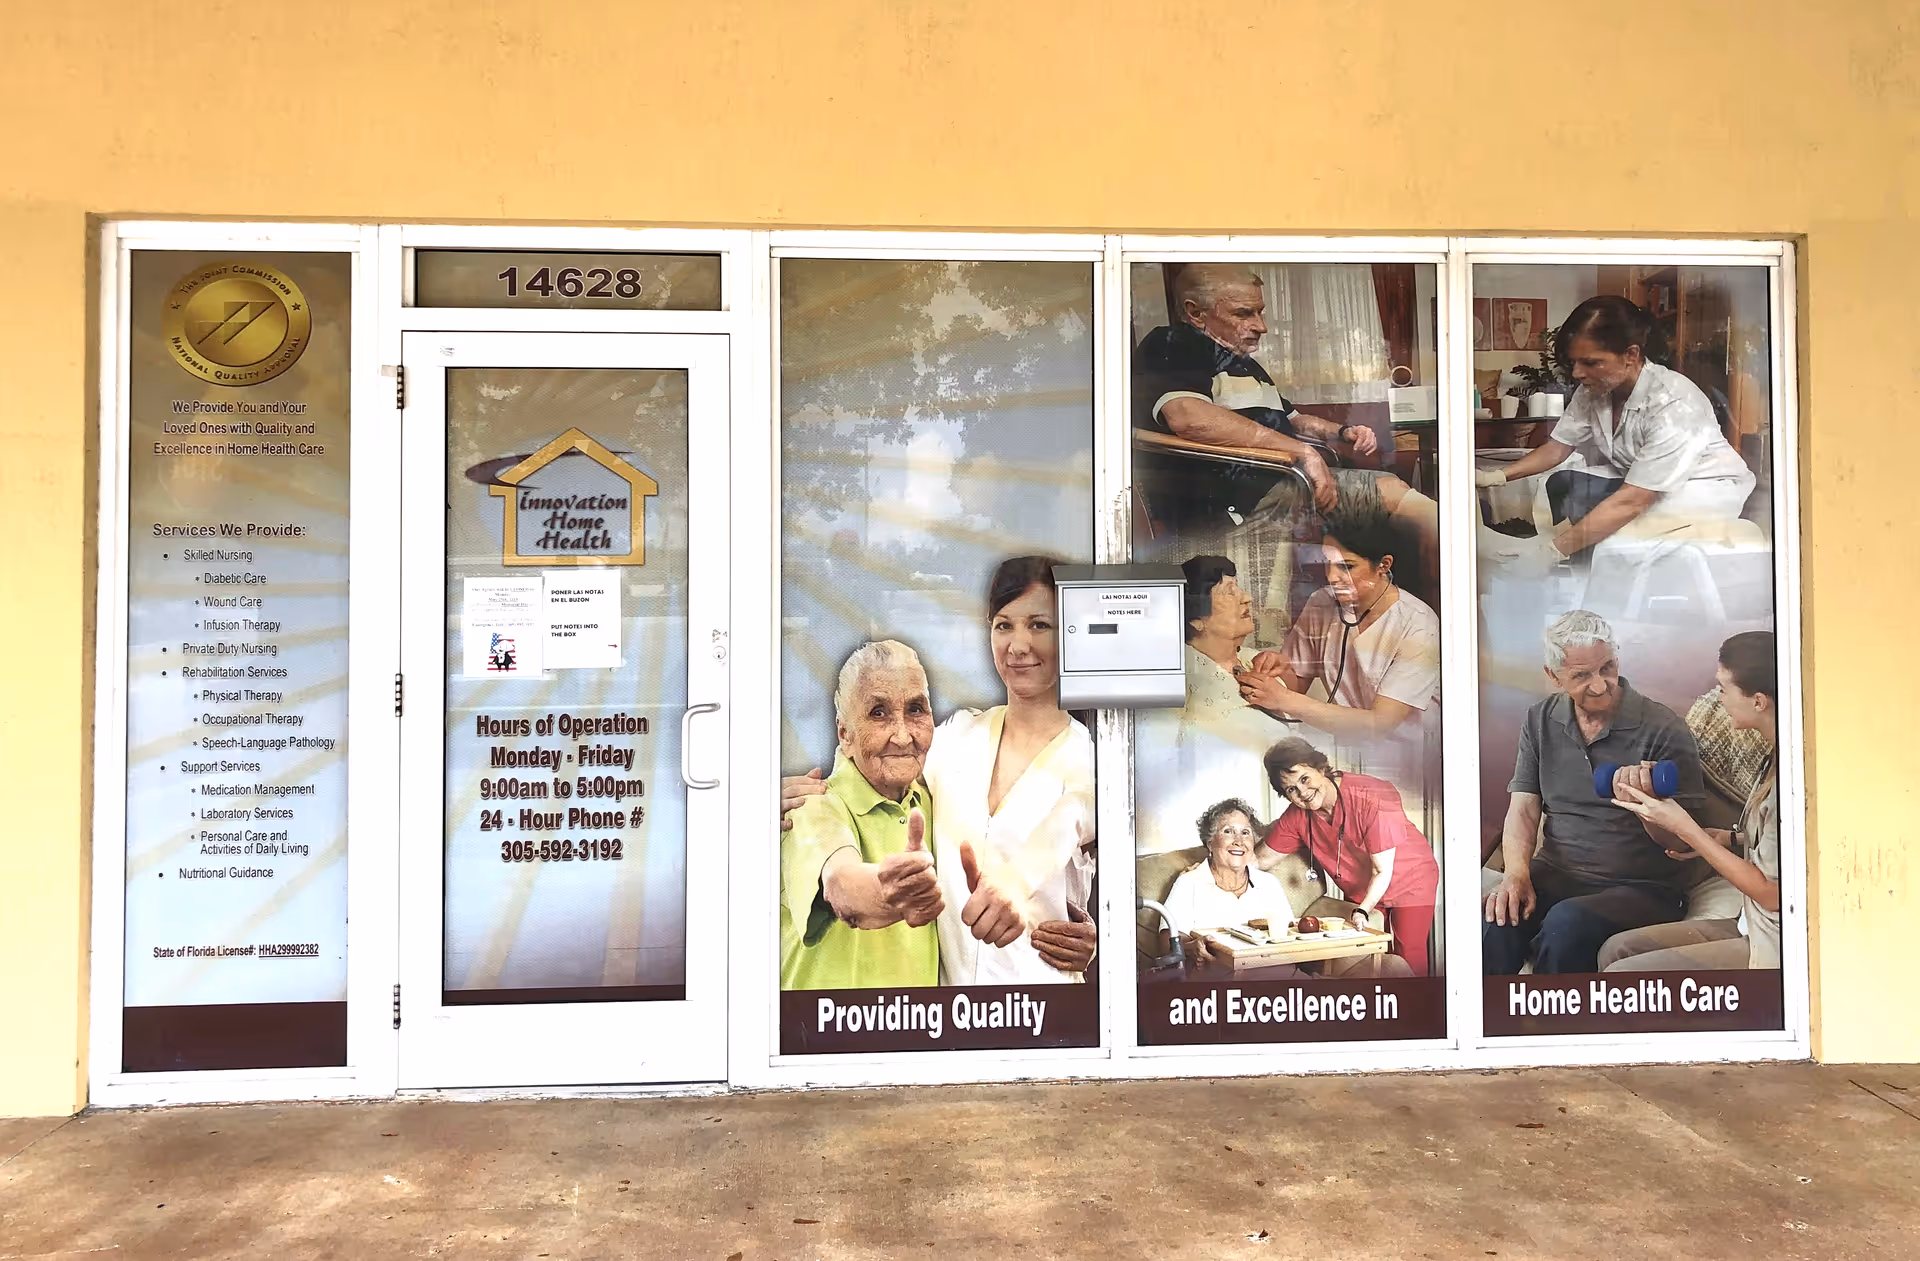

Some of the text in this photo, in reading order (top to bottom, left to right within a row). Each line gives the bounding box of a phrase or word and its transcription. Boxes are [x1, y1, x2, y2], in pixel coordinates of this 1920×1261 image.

[498, 266, 643, 299] 14628
[173, 401, 307, 413] We Provide You and Your
[163, 422, 315, 436] Loved Ones with Quality and
[154, 443, 325, 455] Excellence in Home Health Care
[543, 511, 604, 530] Home
[153, 523, 307, 536] Services We Provide:
[536, 530, 612, 549] Health
[184, 549, 253, 563] Skilled Nursing
[204, 573, 267, 584] Diabetic Care
[203, 596, 262, 607] Wound Care
[203, 619, 281, 632] Infusion Therapy
[182, 643, 277, 656] Private Duty Nursing
[182, 666, 288, 678] Rehabilitation Services
[202, 690, 283, 703] Physical Therapy
[202, 713, 303, 726] Occupational Therapy
[476, 713, 649, 739] Hours of Operation
[202, 736, 335, 750] Speech-Language Pathology
[491, 746, 562, 770] Monday
[578, 744, 634, 769] Friday
[181, 760, 261, 774] Support Services
[201, 784, 315, 797] Medication Management
[480, 776, 644, 801] 9:00am to 5:00pm
[201, 807, 293, 821] Laboratory Services
[480, 810, 503, 830] 24
[519, 808, 563, 829] Hour
[568, 807, 625, 828] Phone
[630, 806, 643, 827] #
[200, 830, 288, 842] Personal Care and
[200, 843, 309, 856] Activities of Daily Living
[501, 838, 623, 861] 305-592-3192
[179, 867, 274, 879] Nutritional Guidance
[153, 947, 175, 958] State
[177, 946, 186, 957] of
[187, 946, 216, 957] Florida
[258, 943, 319, 957] HHA299992382
[1509, 977, 1740, 1016] Home Health Care
[1169, 985, 1398, 1025] and Excellence in
[817, 992, 1046, 1039] Providing Quality
